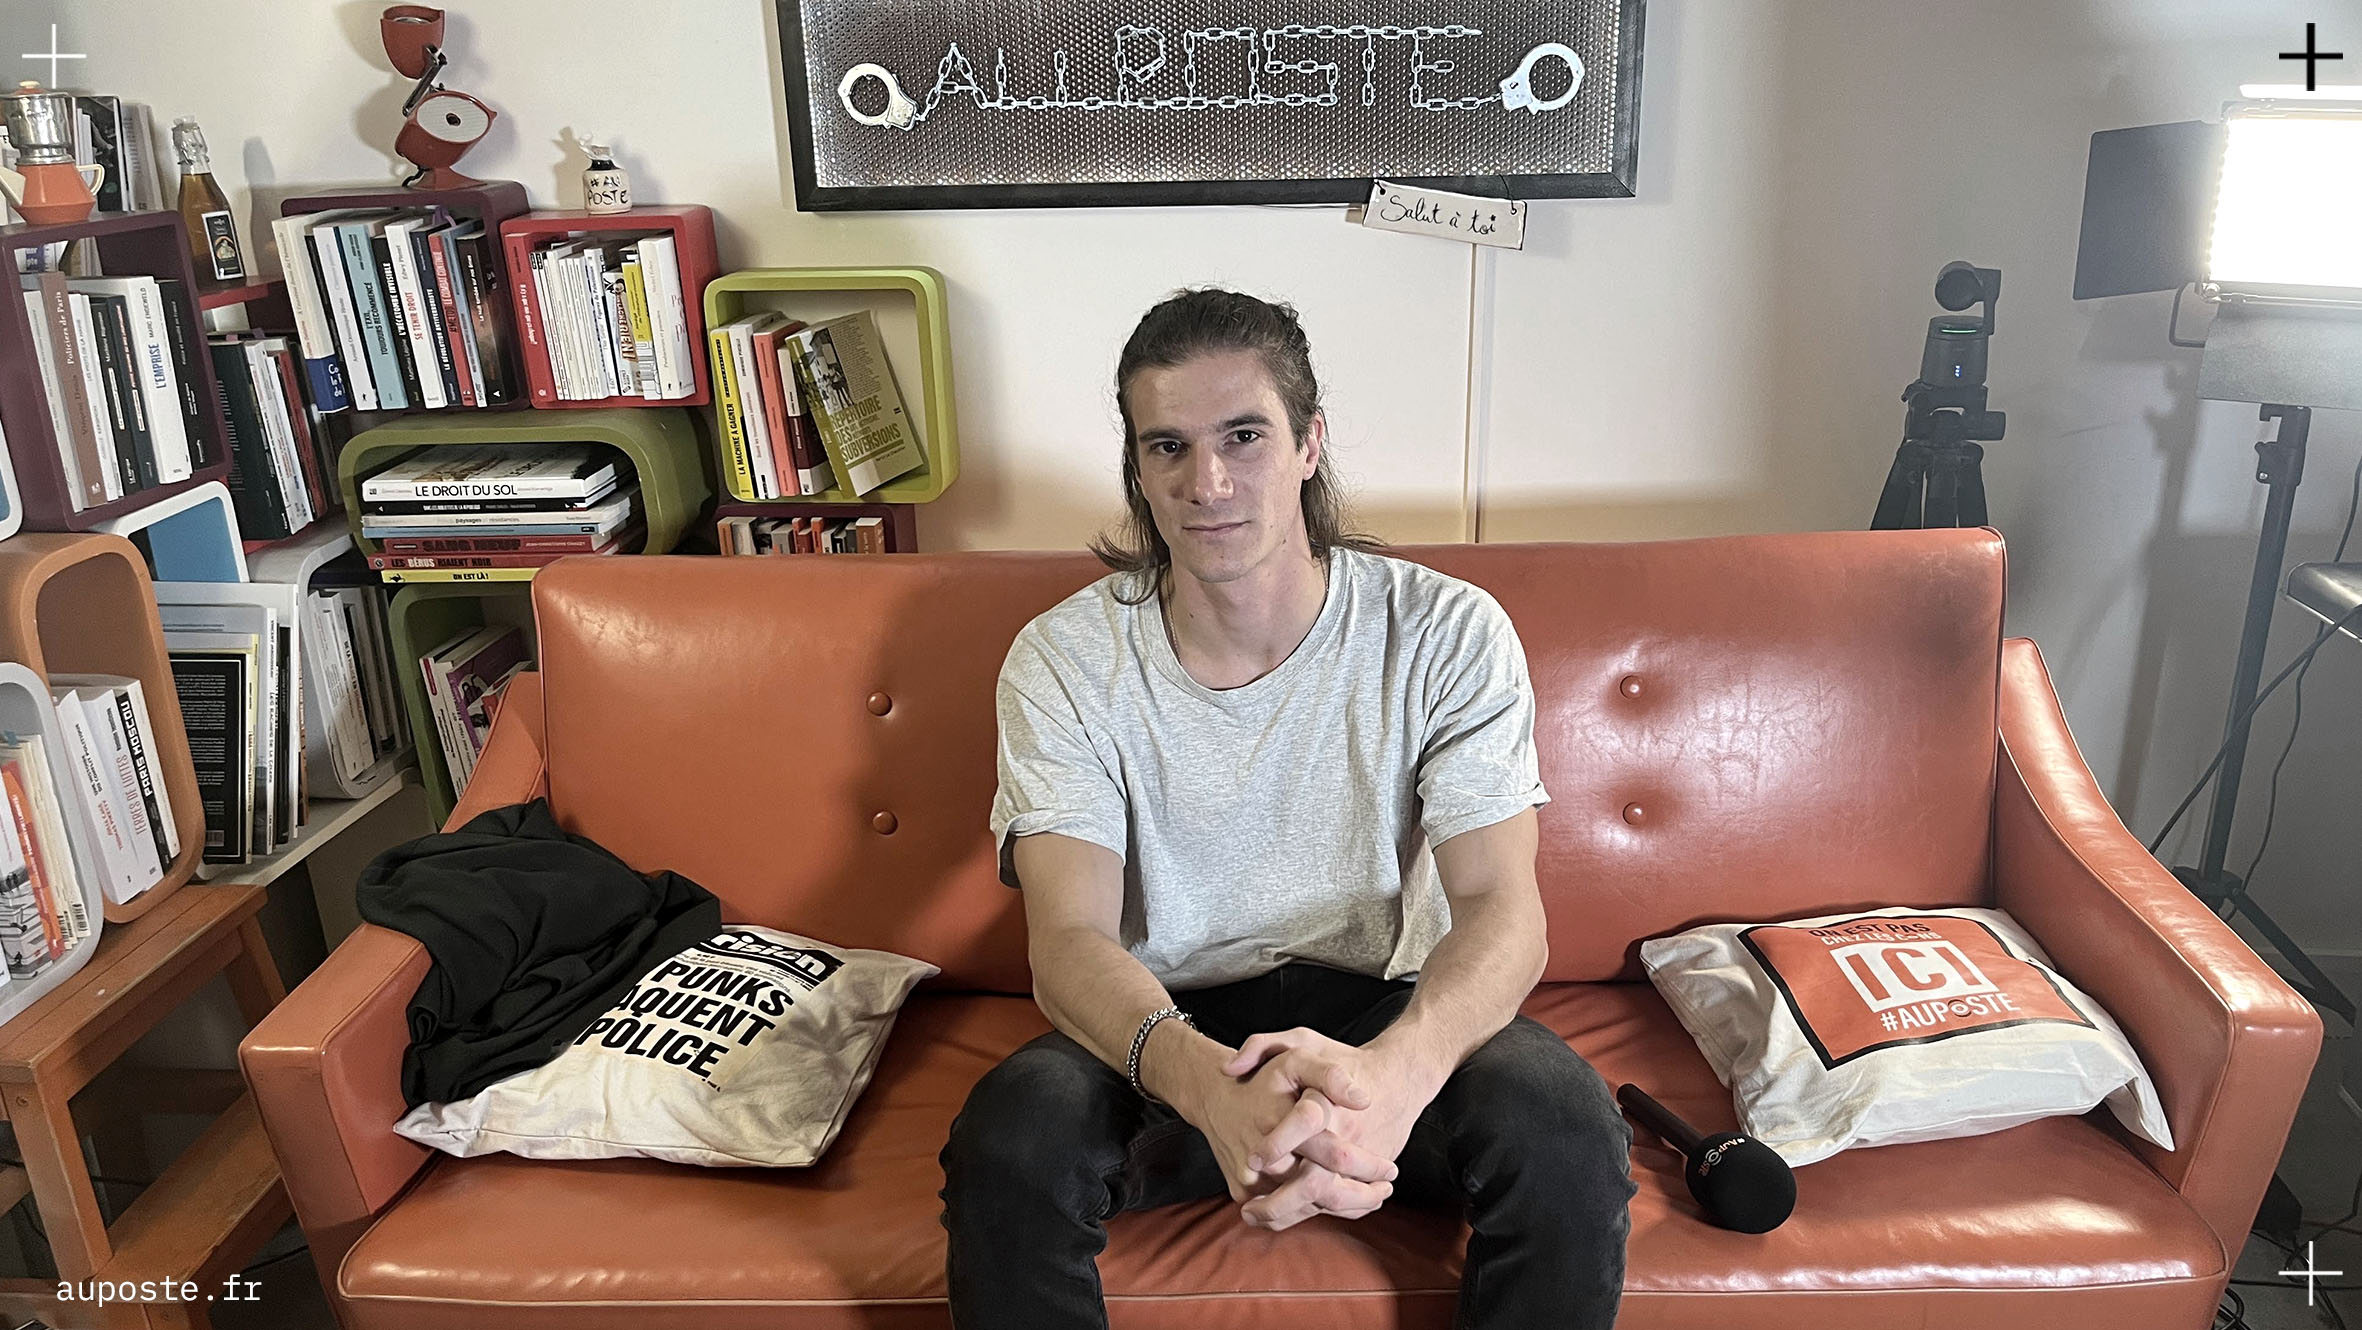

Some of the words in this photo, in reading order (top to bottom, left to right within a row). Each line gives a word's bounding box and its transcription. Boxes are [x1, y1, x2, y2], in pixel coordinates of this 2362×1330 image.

[587, 189, 629, 206] POSTE
[1380, 195, 1443, 224] Salut
[1450, 212, 1461, 229] à
[1467, 210, 1496, 235] toi
[382, 262, 397, 293] INVISIBLE
[52, 290, 64, 313] Paris
[363, 280, 380, 325] RECOMMENCÉ
[404, 290, 416, 311] DROIT
[595, 301, 603, 319] Figures
[57, 314, 66, 326] de
[146, 320, 155, 337] MARC
[409, 312, 421, 331] TENIR
[60, 327, 74, 364] Policiers
[414, 332, 423, 340] SE
[147, 343, 166, 388] L'EMPRISE
[724, 402, 738, 429] GAGNER
[833, 425, 853, 444] DES
[837, 422, 902, 460] SUBVERSIONS
[730, 436, 745, 465] MACHINE
[737, 465, 746, 475] LA
[415, 486, 428, 496] LE
[431, 485, 469, 496] DROIT
[472, 484, 490, 496] DU
[493, 484, 517, 496] SOL
[392, 560, 405, 568] LES
[345, 649, 351, 657] LA
[75, 723, 90, 756] POLITIQUE
[120, 700, 142, 755] MOSCOU
[87, 756, 98, 782] CONFLIT
[115, 754, 135, 789] LUTTES
[135, 756, 153, 796] PARIS
[124, 787, 138, 801] DE
[127, 800, 147, 835] TERRES
[1808, 928, 1840, 938] ON
[1843, 924, 1881, 935] EST
[1889, 922, 1930, 934] PAS
[1821, 931, 1863, 946] CHEZ
[1865, 930, 1894, 942] LES
[710, 934, 826, 976] risien
[1845, 946, 1982, 1002] ICI
[653, 960, 794, 1016] PUNKS
[1880, 992, 2021, 1032] #AUPOSTE
[573, 1018, 729, 1078] POLICE
